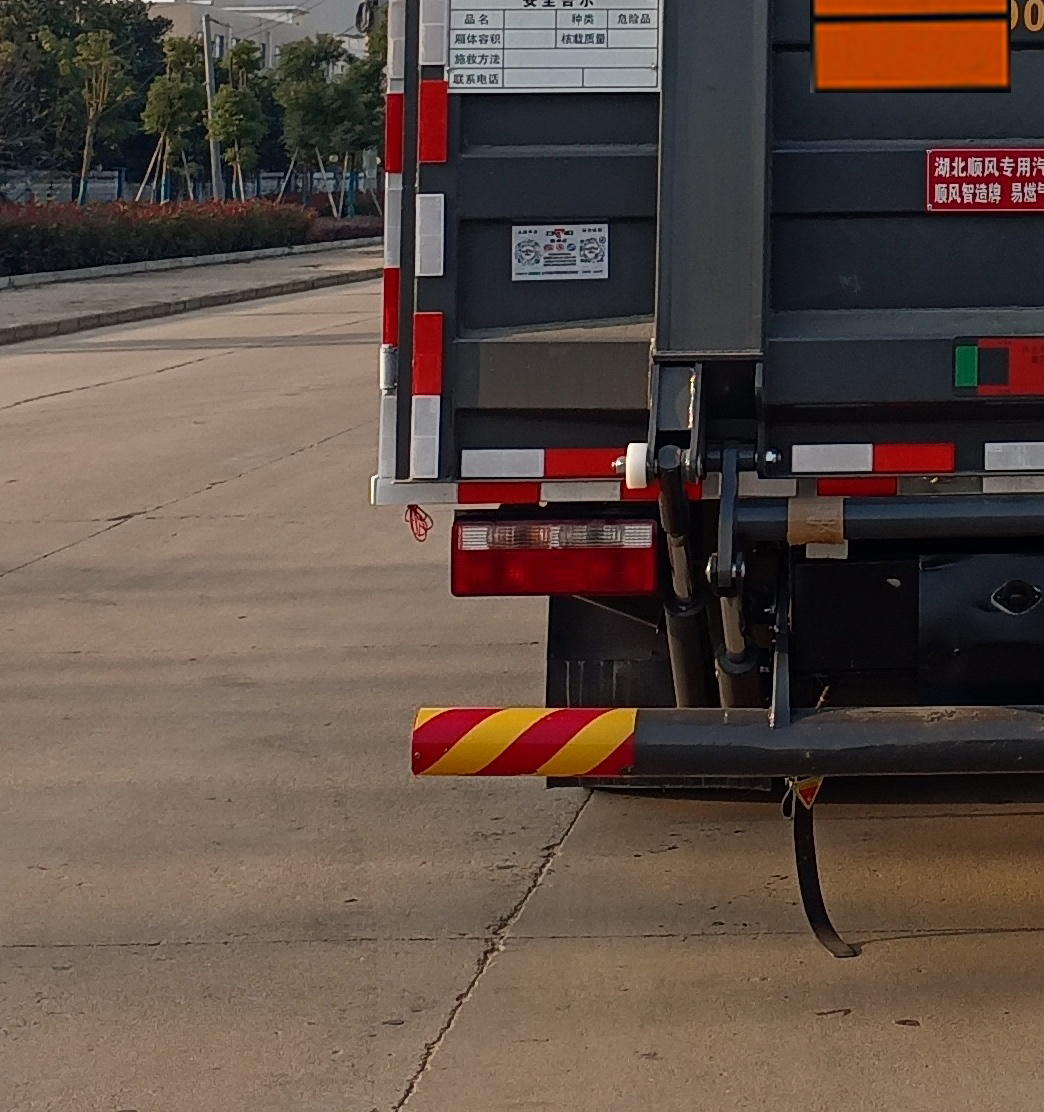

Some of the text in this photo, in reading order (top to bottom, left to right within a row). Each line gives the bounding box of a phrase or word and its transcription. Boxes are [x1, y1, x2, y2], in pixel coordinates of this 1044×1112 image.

[464, 13, 489, 26] 品名
[571, 13, 594, 26] 种类
[617, 13, 651, 25] 危险品
[454, 33, 501, 45] 厢体容积
[454, 53, 501, 66] 施救方法
[453, 73, 500, 85] 联系电话
[933, 182, 1002, 204] 顺风智造牌
